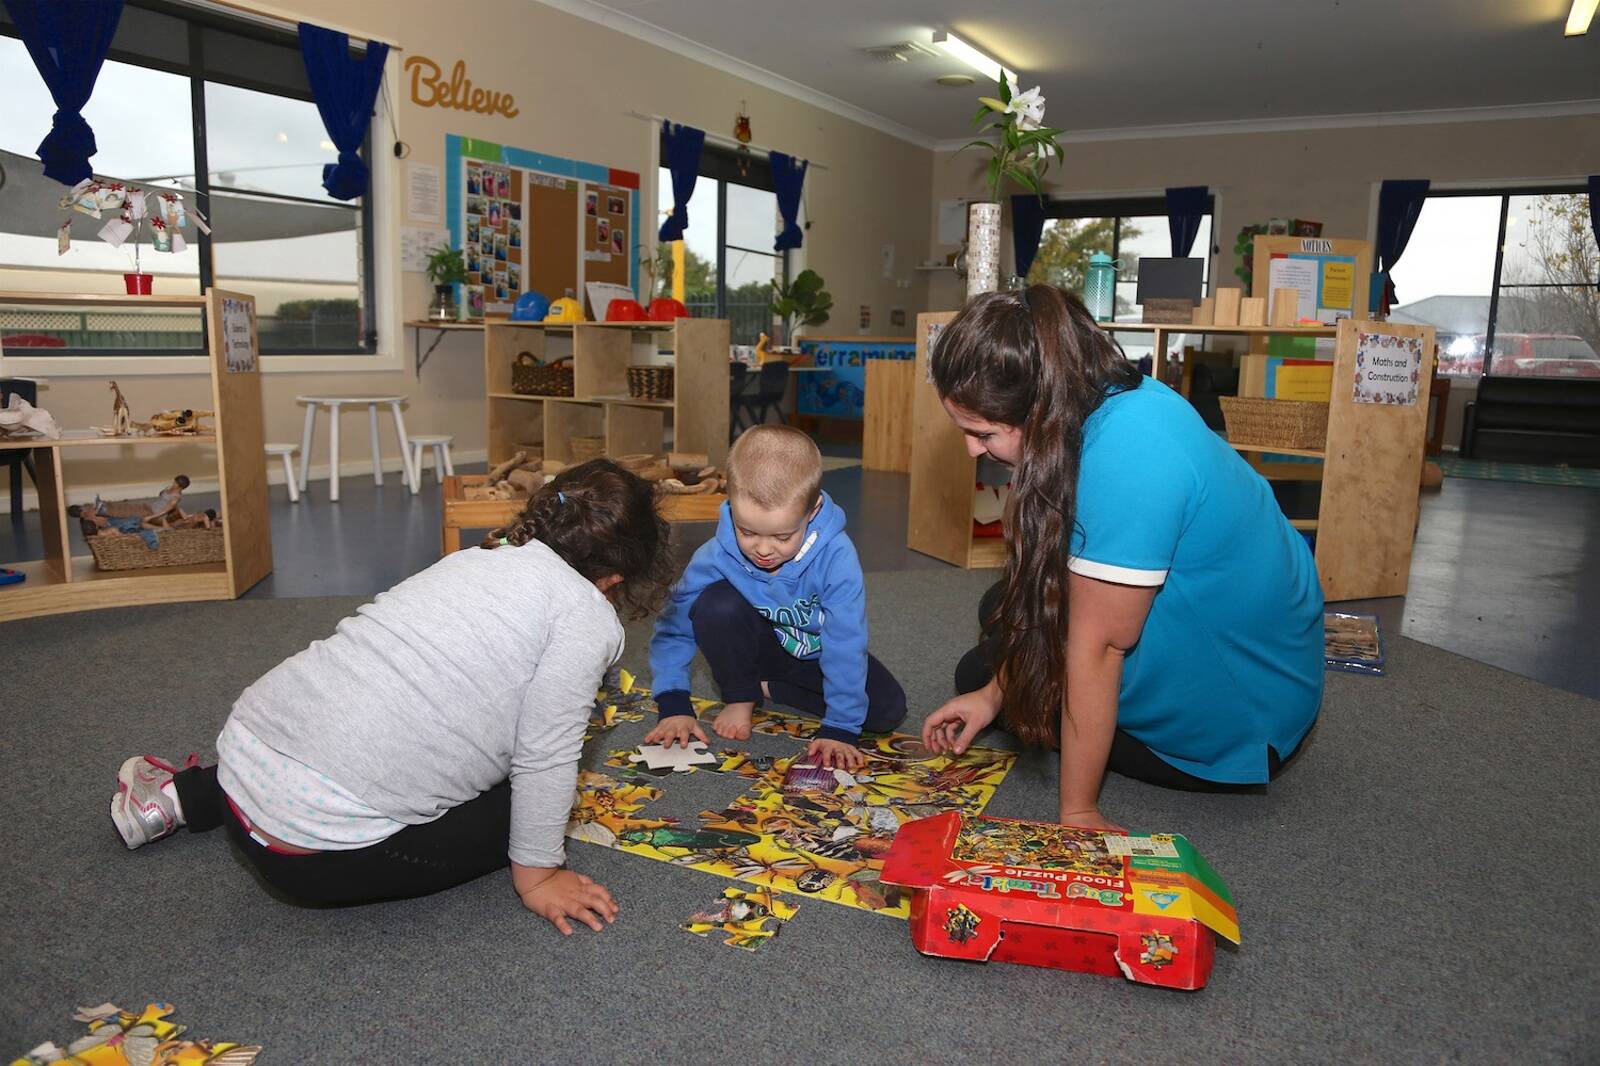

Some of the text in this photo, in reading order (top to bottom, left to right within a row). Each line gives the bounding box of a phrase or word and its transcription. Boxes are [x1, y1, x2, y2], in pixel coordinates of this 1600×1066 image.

[404, 55, 519, 118] Believe
[1301, 239, 1332, 253] NOTICES
[1372, 356, 1408, 368] Maths and
[1367, 371, 1409, 382] Construction
[1005, 867, 1068, 883] Puzzle
[1074, 873, 1125, 889] Floor
[969, 874, 1061, 899] Tumble
[1067, 882, 1124, 906] Bug
